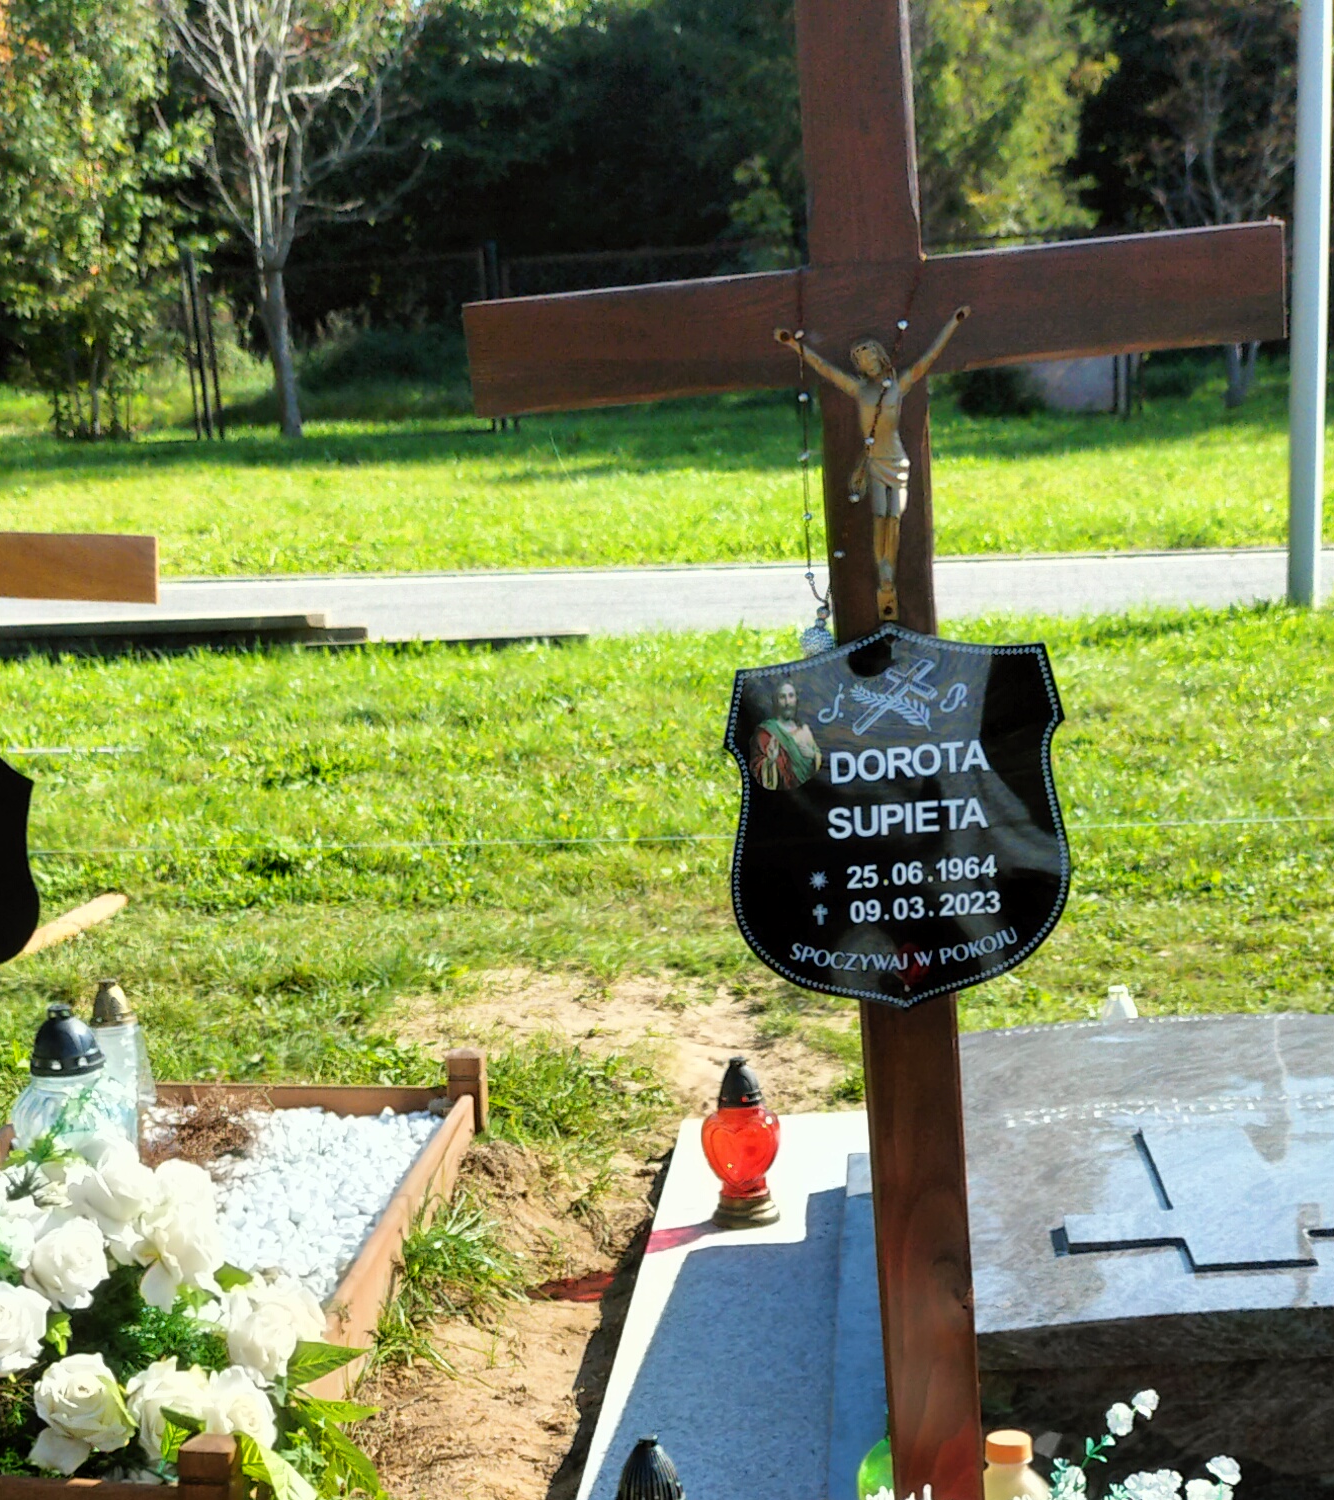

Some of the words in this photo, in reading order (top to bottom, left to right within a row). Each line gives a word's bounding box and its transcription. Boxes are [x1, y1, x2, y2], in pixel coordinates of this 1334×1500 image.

[829, 740, 990, 784] DOROTA
[827, 797, 989, 839] SUPIETA
[846, 854, 998, 890] 25.06.1964
[849, 890, 1001, 924] 09.03.2023
[789, 942, 908, 972] SPOCZYWAJ
[914, 951, 933, 968] W
[939, 926, 1018, 966] POKOJU
